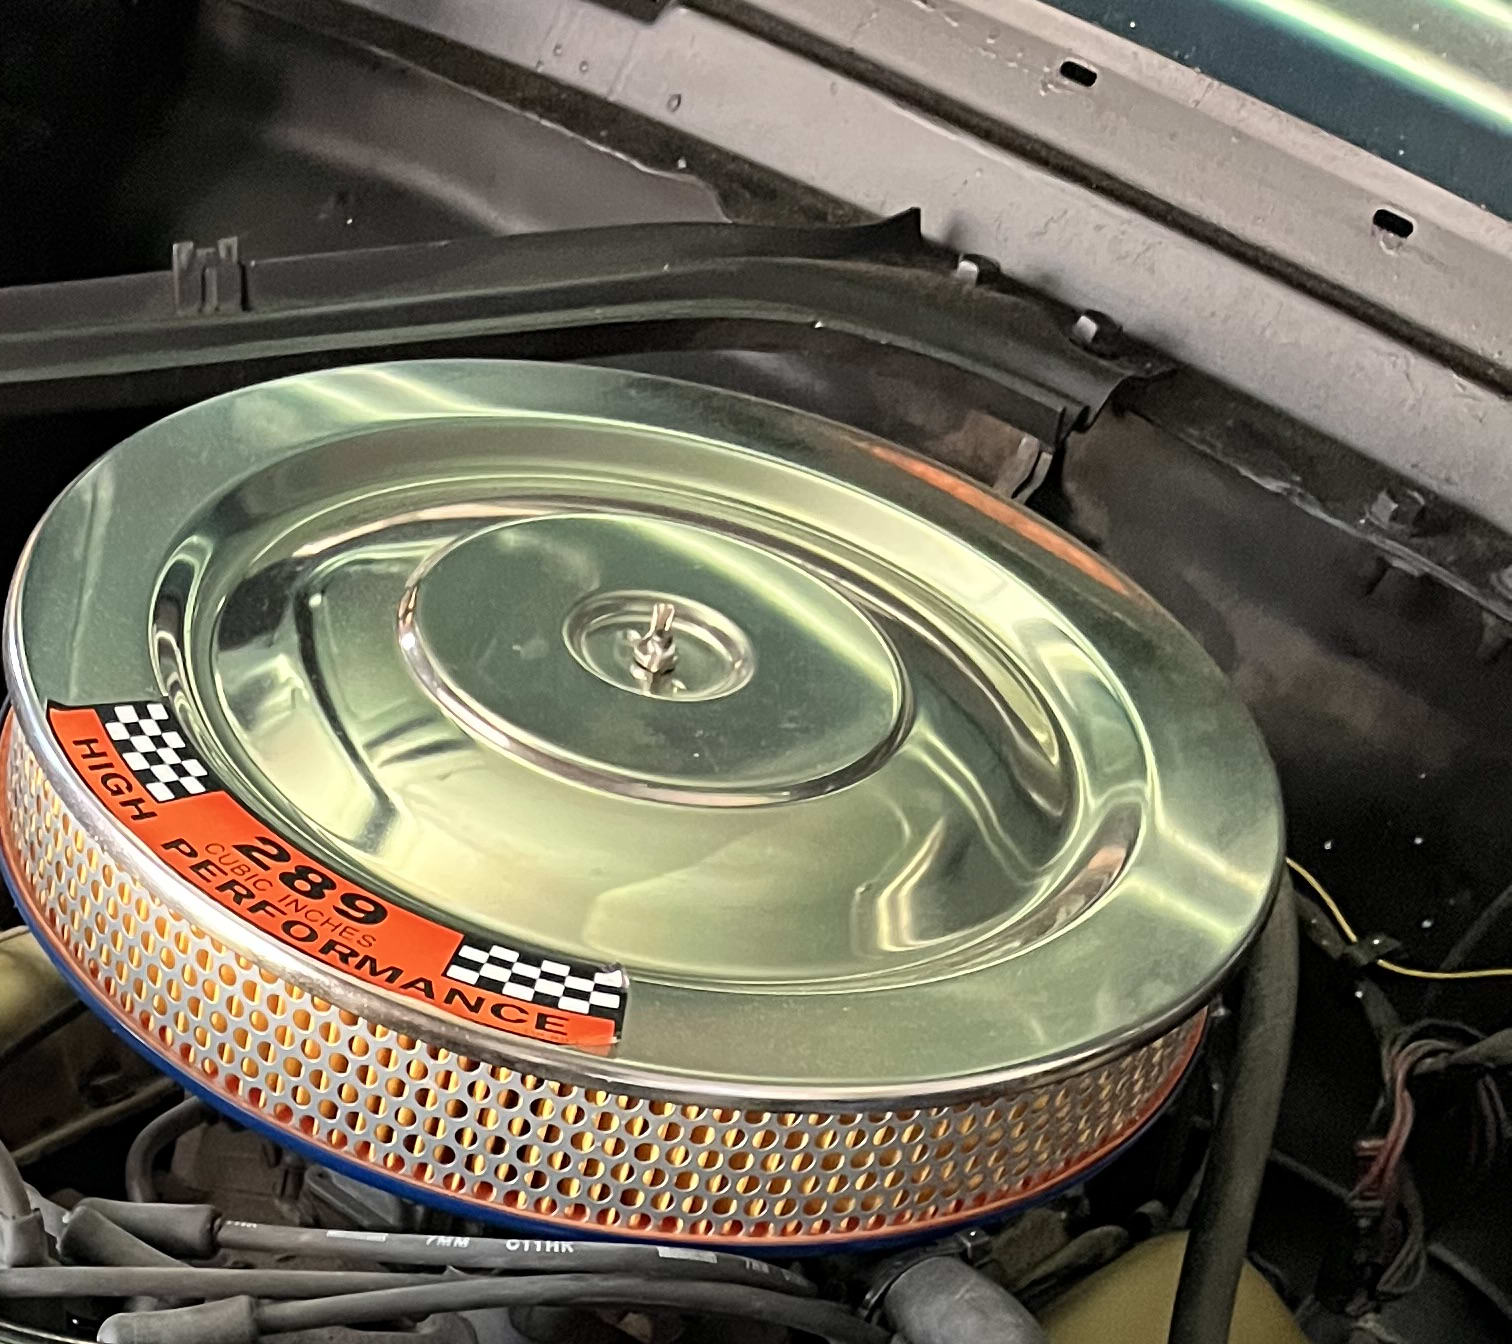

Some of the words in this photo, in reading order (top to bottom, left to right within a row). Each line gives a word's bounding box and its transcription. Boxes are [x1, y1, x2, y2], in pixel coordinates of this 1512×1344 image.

[72, 738, 158, 821] HIGH
[161, 838, 569, 1036] PERFORMANCE
[205, 842, 273, 892] CUBIC
[277, 894, 377, 948] INCHES
[232, 836, 388, 925] 289
